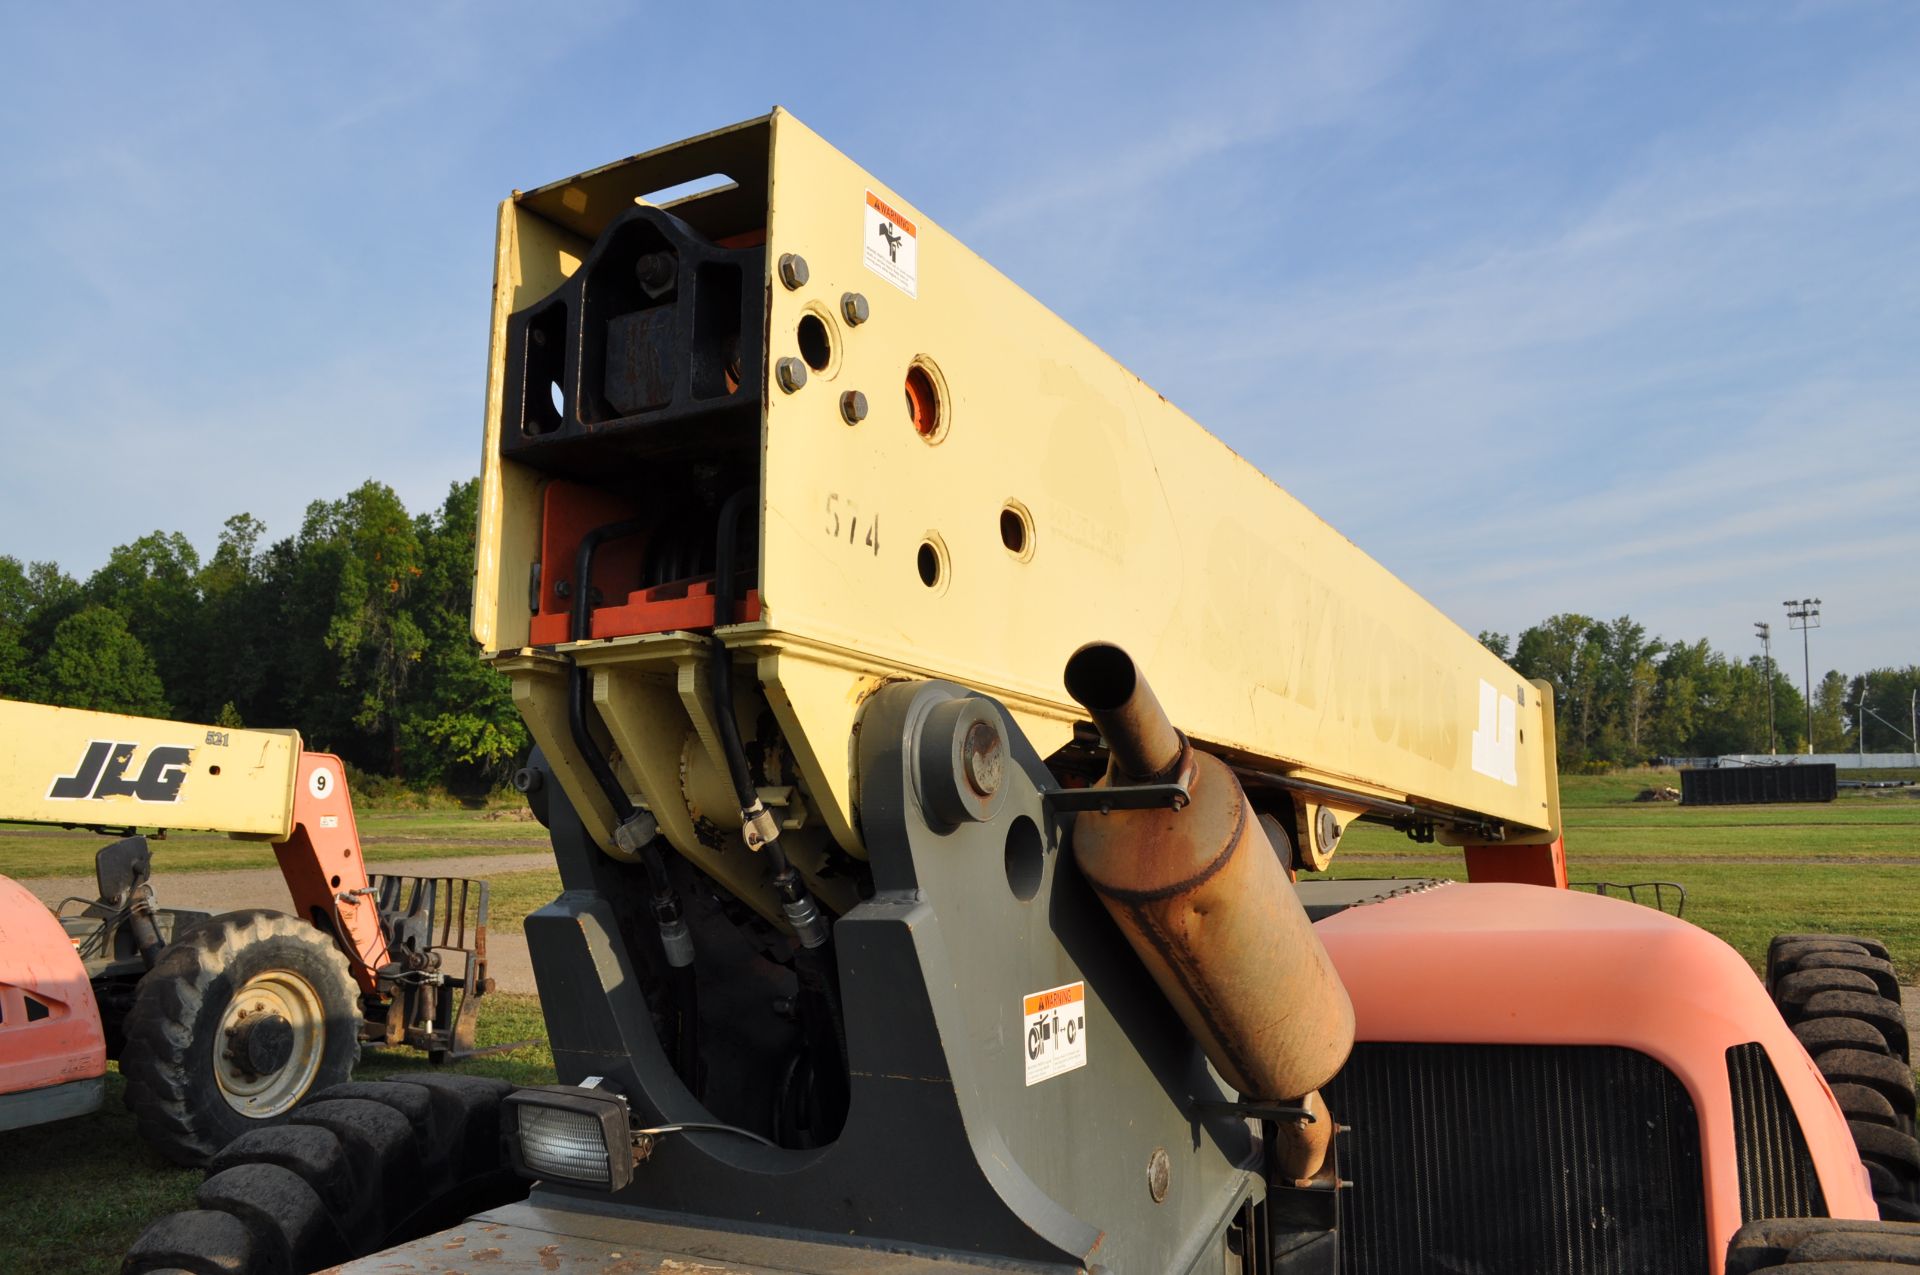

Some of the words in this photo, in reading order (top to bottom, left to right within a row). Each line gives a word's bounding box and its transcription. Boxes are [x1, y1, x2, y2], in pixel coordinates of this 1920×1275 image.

[879, 200, 910, 232] WARNING
[206, 730, 229, 747] 521
[48, 739, 194, 803] JLG
[317, 776, 326, 791] 9
[1045, 989, 1072, 1008] WARNING
